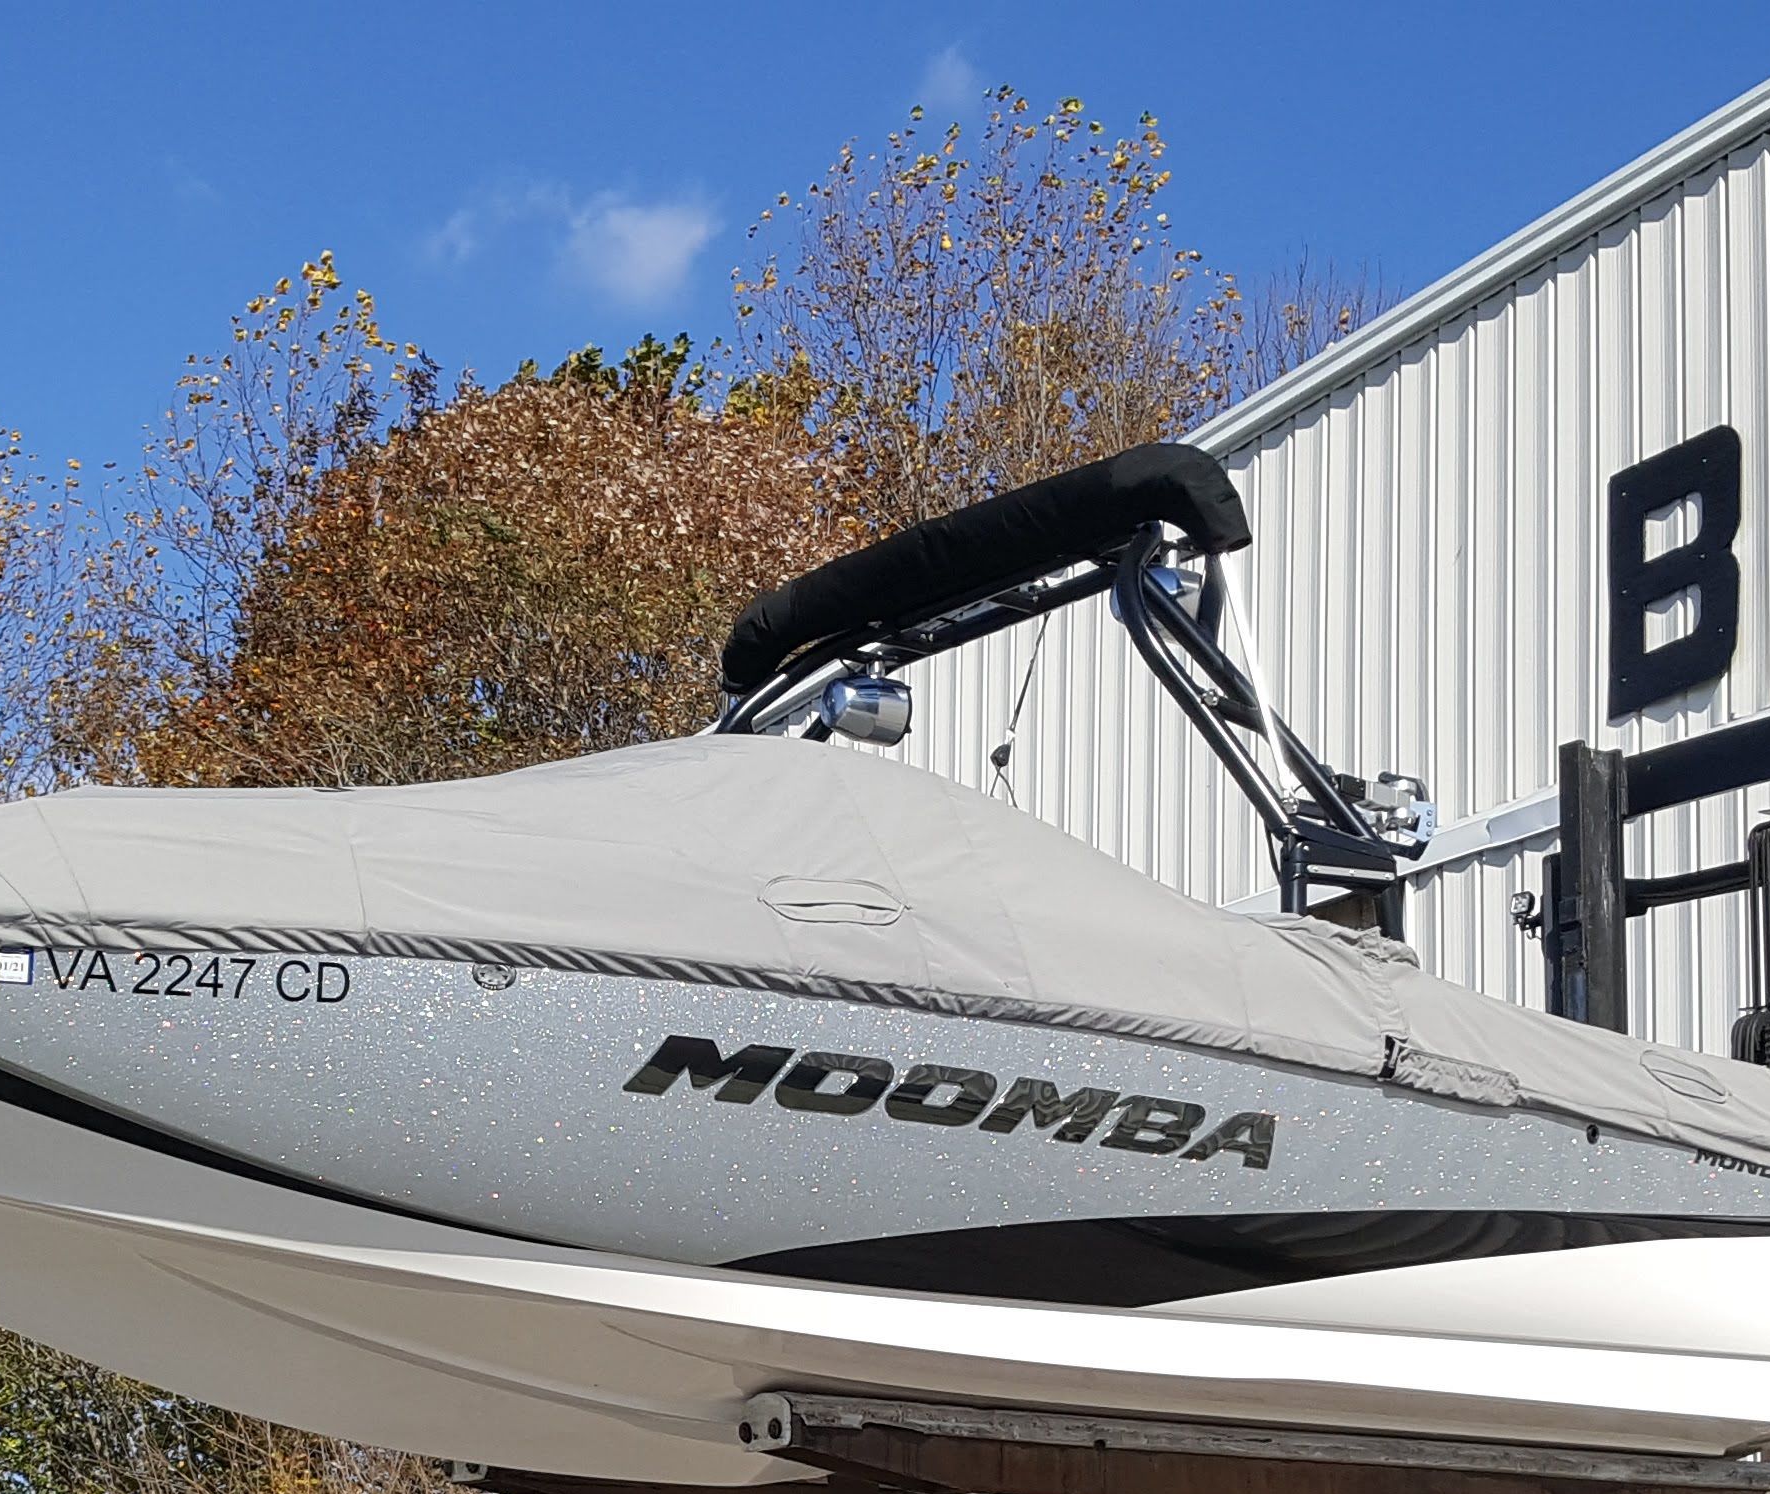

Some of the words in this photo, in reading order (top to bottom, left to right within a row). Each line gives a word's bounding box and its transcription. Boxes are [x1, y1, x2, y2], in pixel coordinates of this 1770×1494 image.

[46, 947, 117, 992] VA
[132, 952, 257, 998] 2247
[276, 959, 351, 1002] CD
[622, 1035, 1278, 1170] MOOMBA
